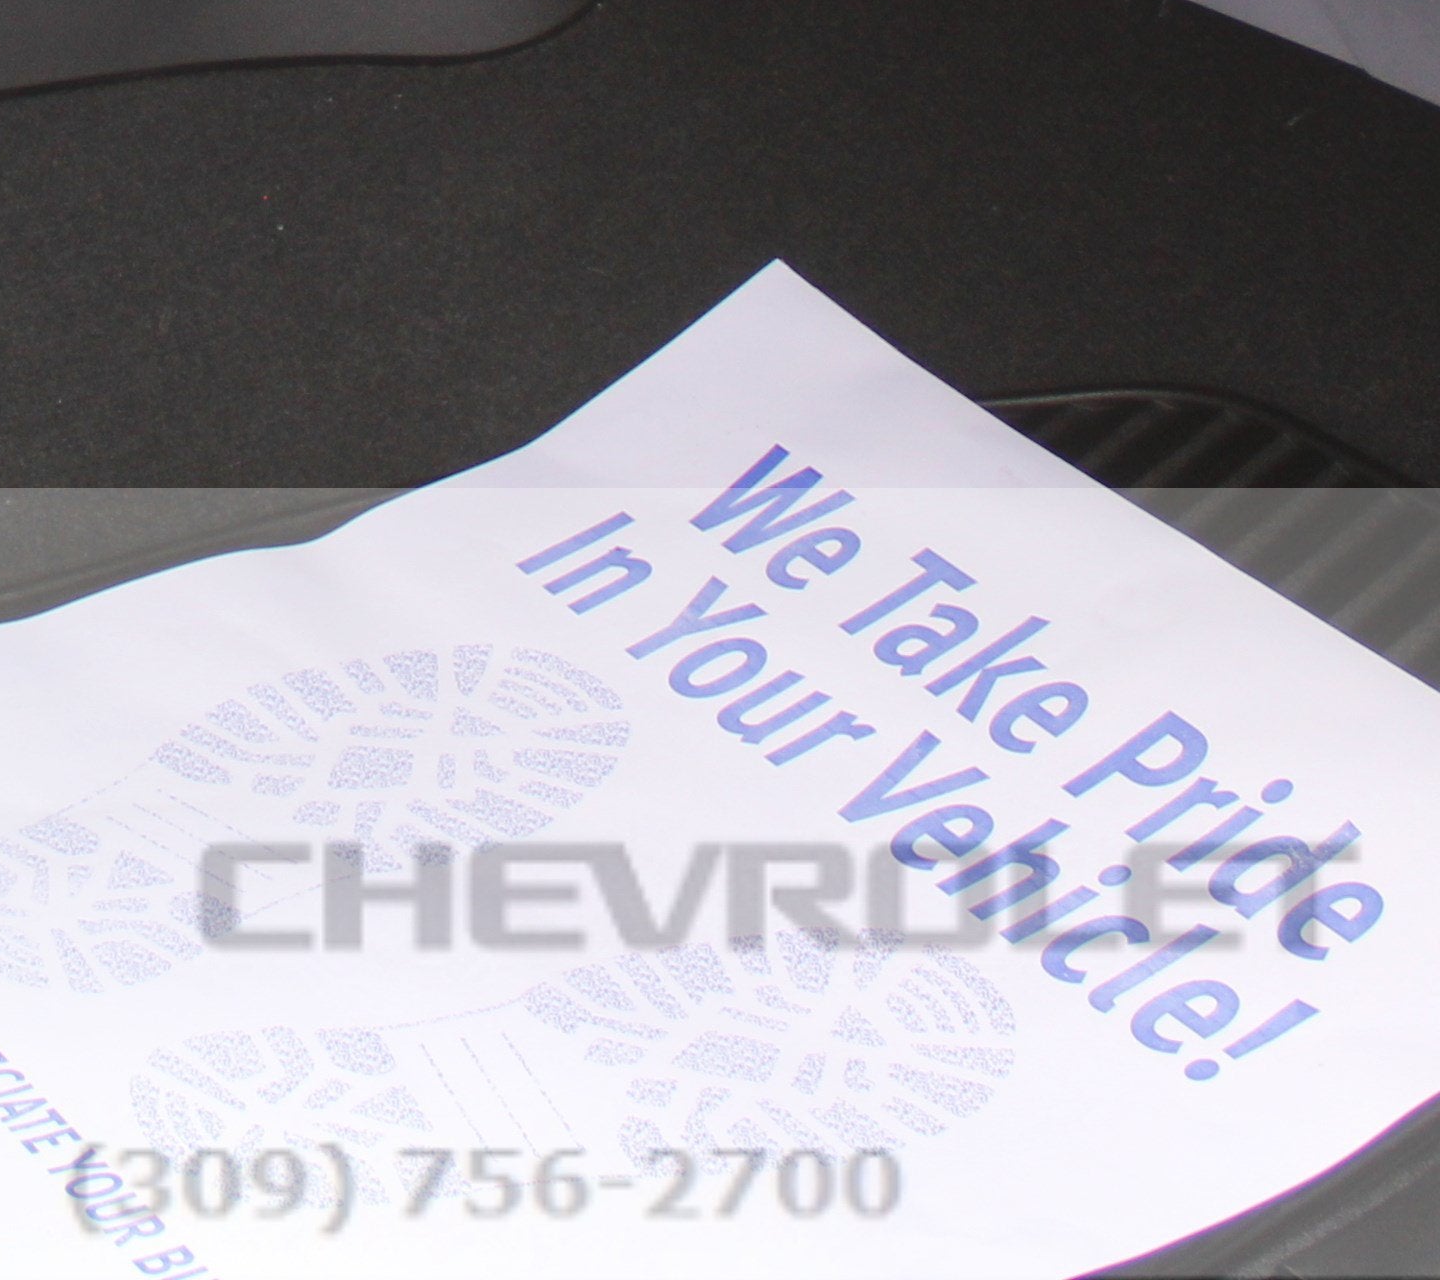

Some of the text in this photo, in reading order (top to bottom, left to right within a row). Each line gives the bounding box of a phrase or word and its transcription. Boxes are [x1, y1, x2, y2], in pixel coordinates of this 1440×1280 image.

[515, 510, 1321, 1082] In Your Vehicle!
[688, 443, 1385, 961] We Take Pride
[47, 1147, 166, 1247] YOUR
